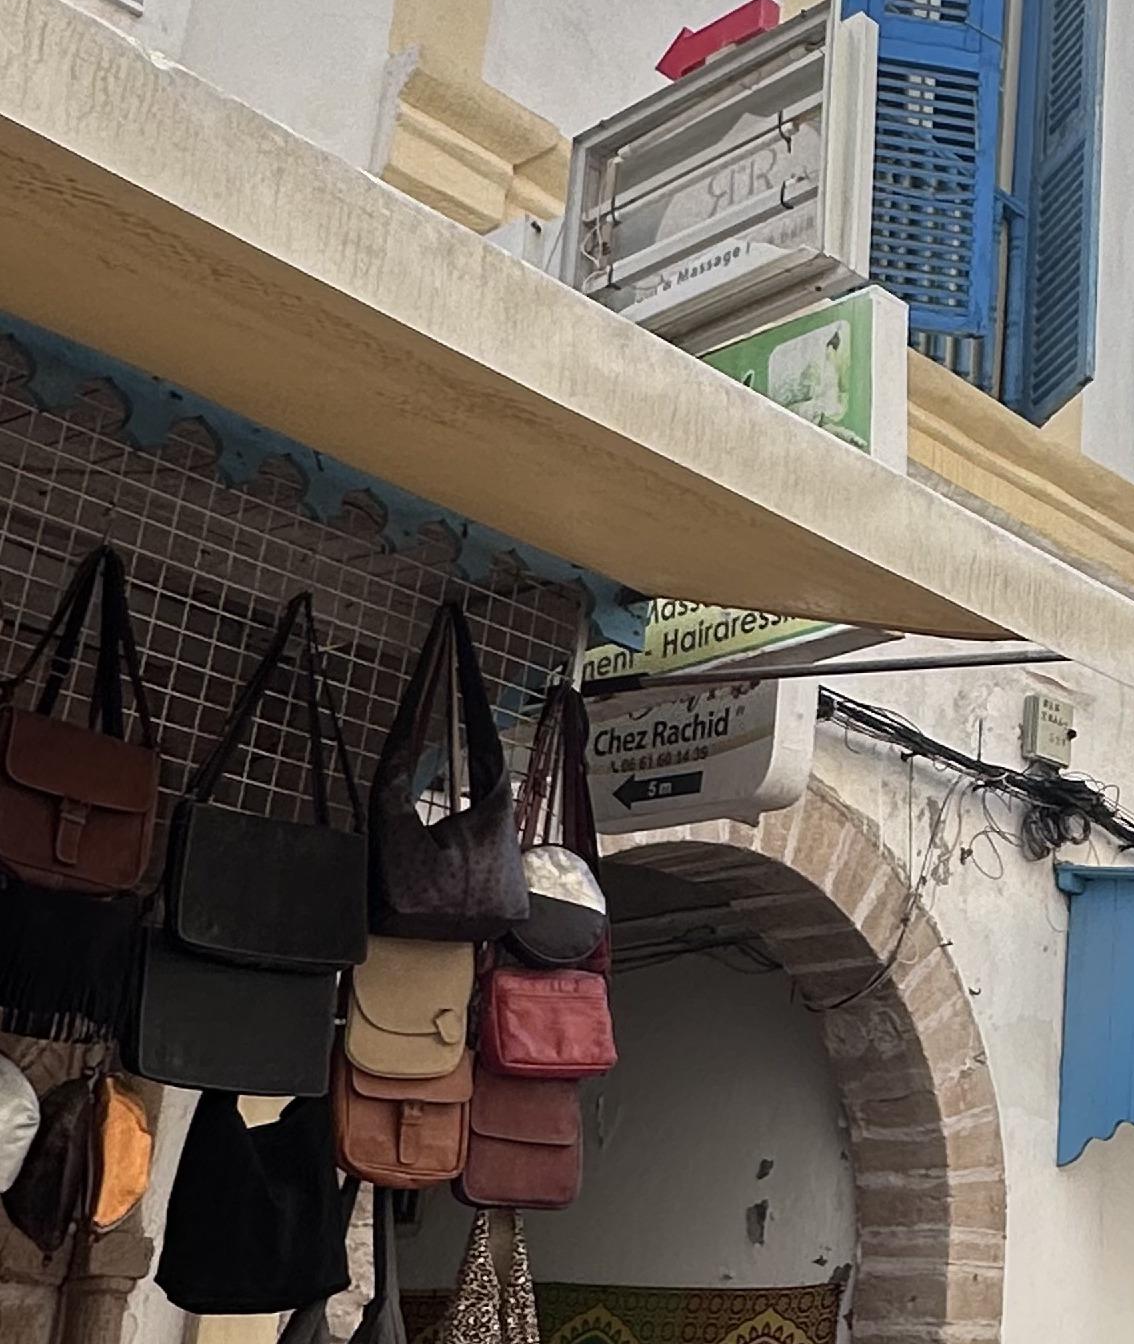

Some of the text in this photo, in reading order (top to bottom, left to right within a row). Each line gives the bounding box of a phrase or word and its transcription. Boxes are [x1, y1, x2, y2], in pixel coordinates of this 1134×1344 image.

[676, 246, 741, 285] Massage
[646, 599, 700, 627] ass
[594, 727, 648, 756] Chez
[652, 707, 731, 748] Rachid
